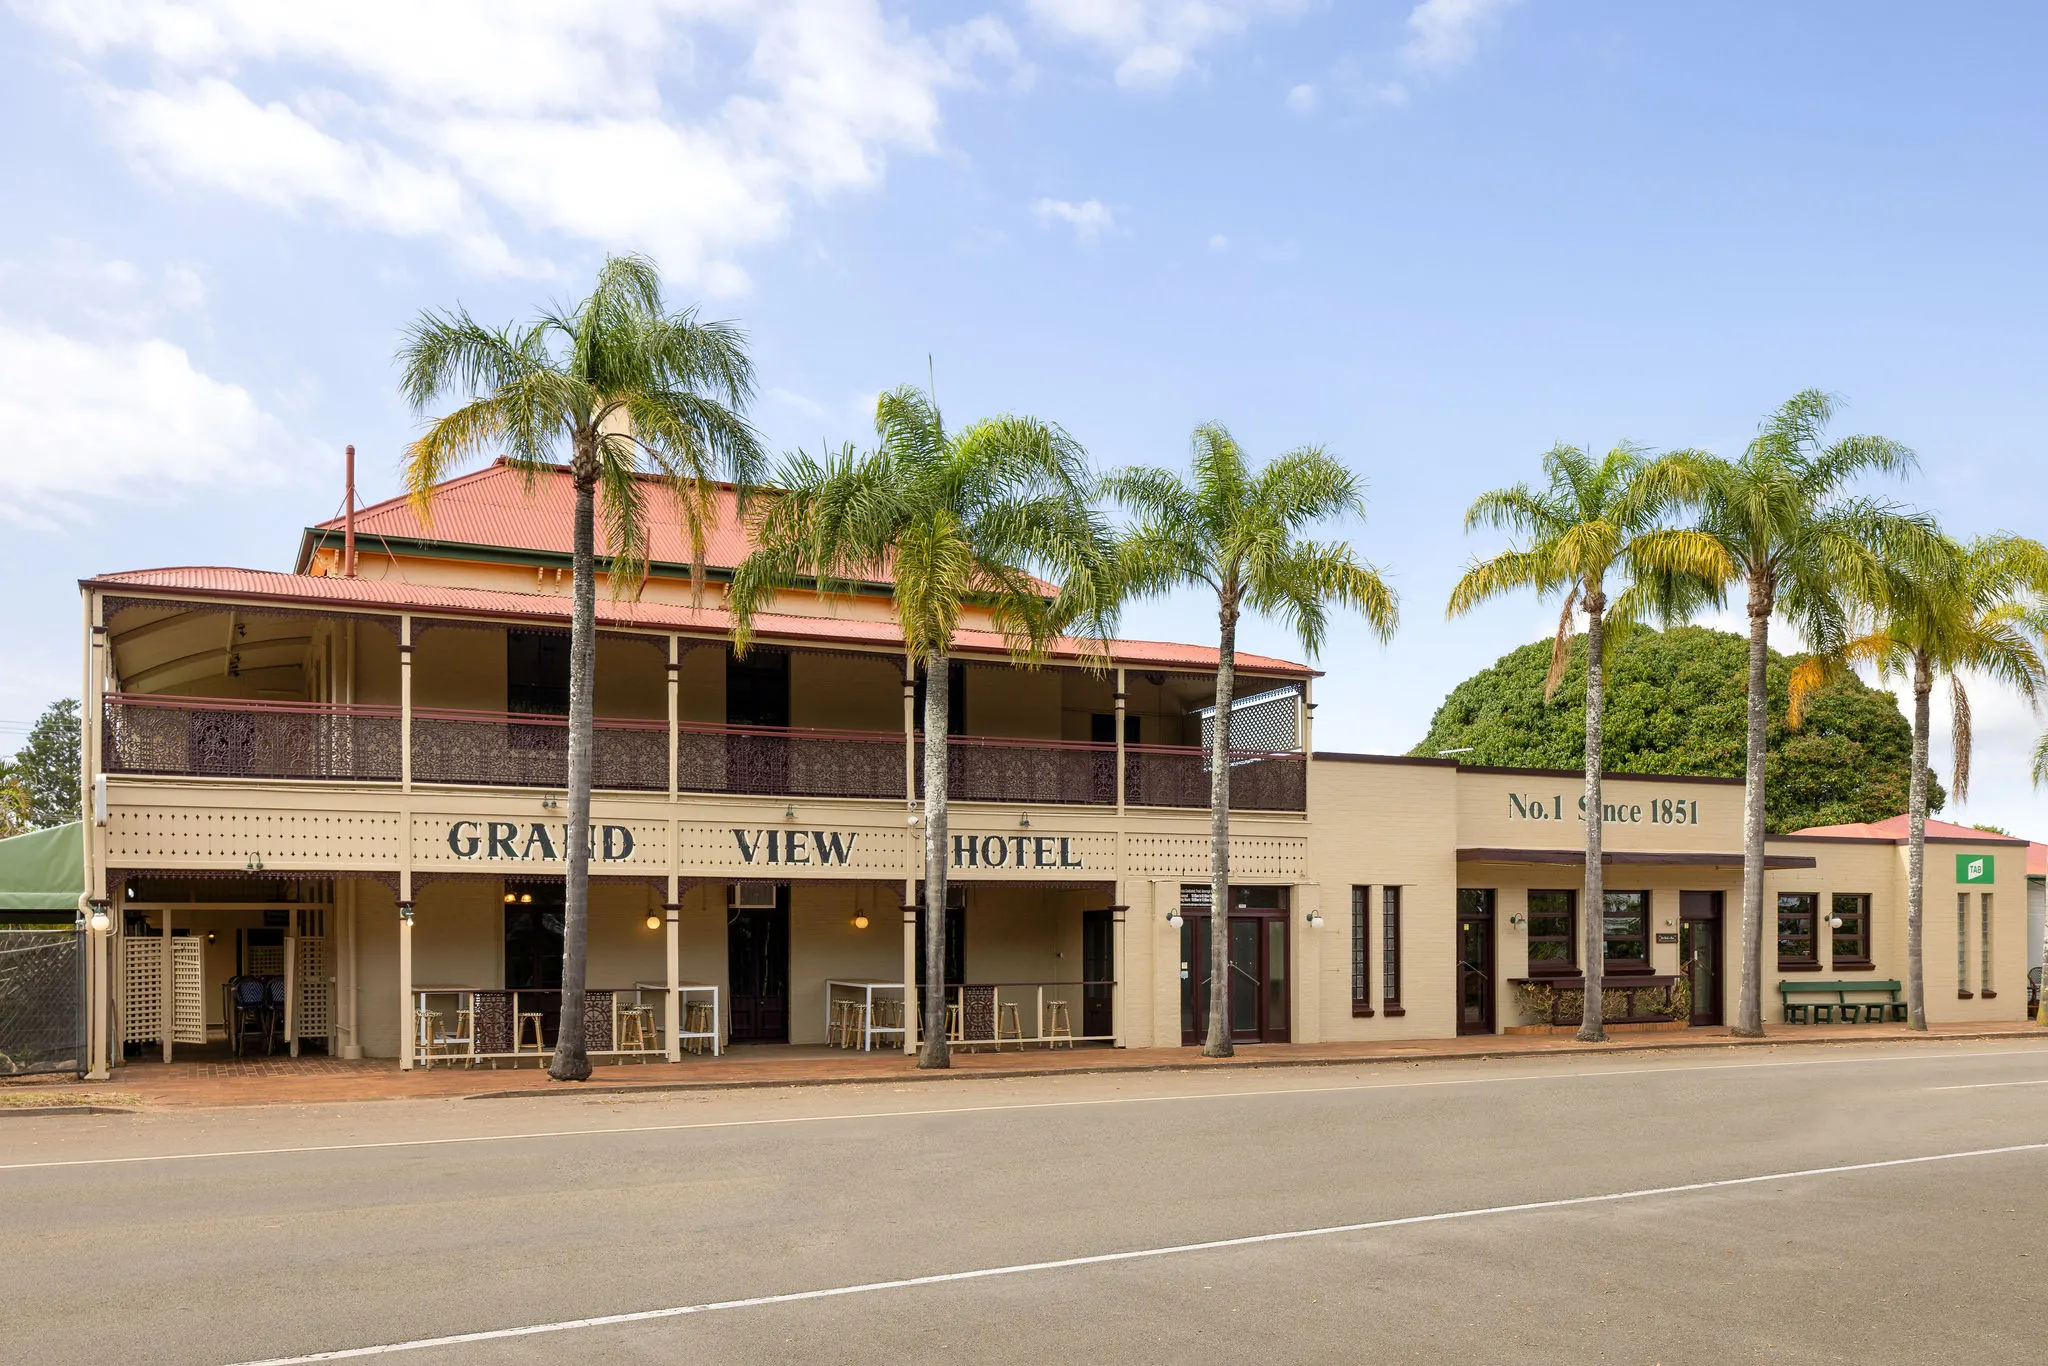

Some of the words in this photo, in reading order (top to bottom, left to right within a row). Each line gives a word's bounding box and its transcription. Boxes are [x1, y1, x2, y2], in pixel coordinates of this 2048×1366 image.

[1508, 793, 1562, 820] No.1
[1577, 795, 1642, 823] Snce
[1651, 798, 1698, 825] 1851
[731, 828, 858, 865] VIEW
[953, 835, 1082, 868] HOTEL
[1969, 865, 1982, 874] TAB
